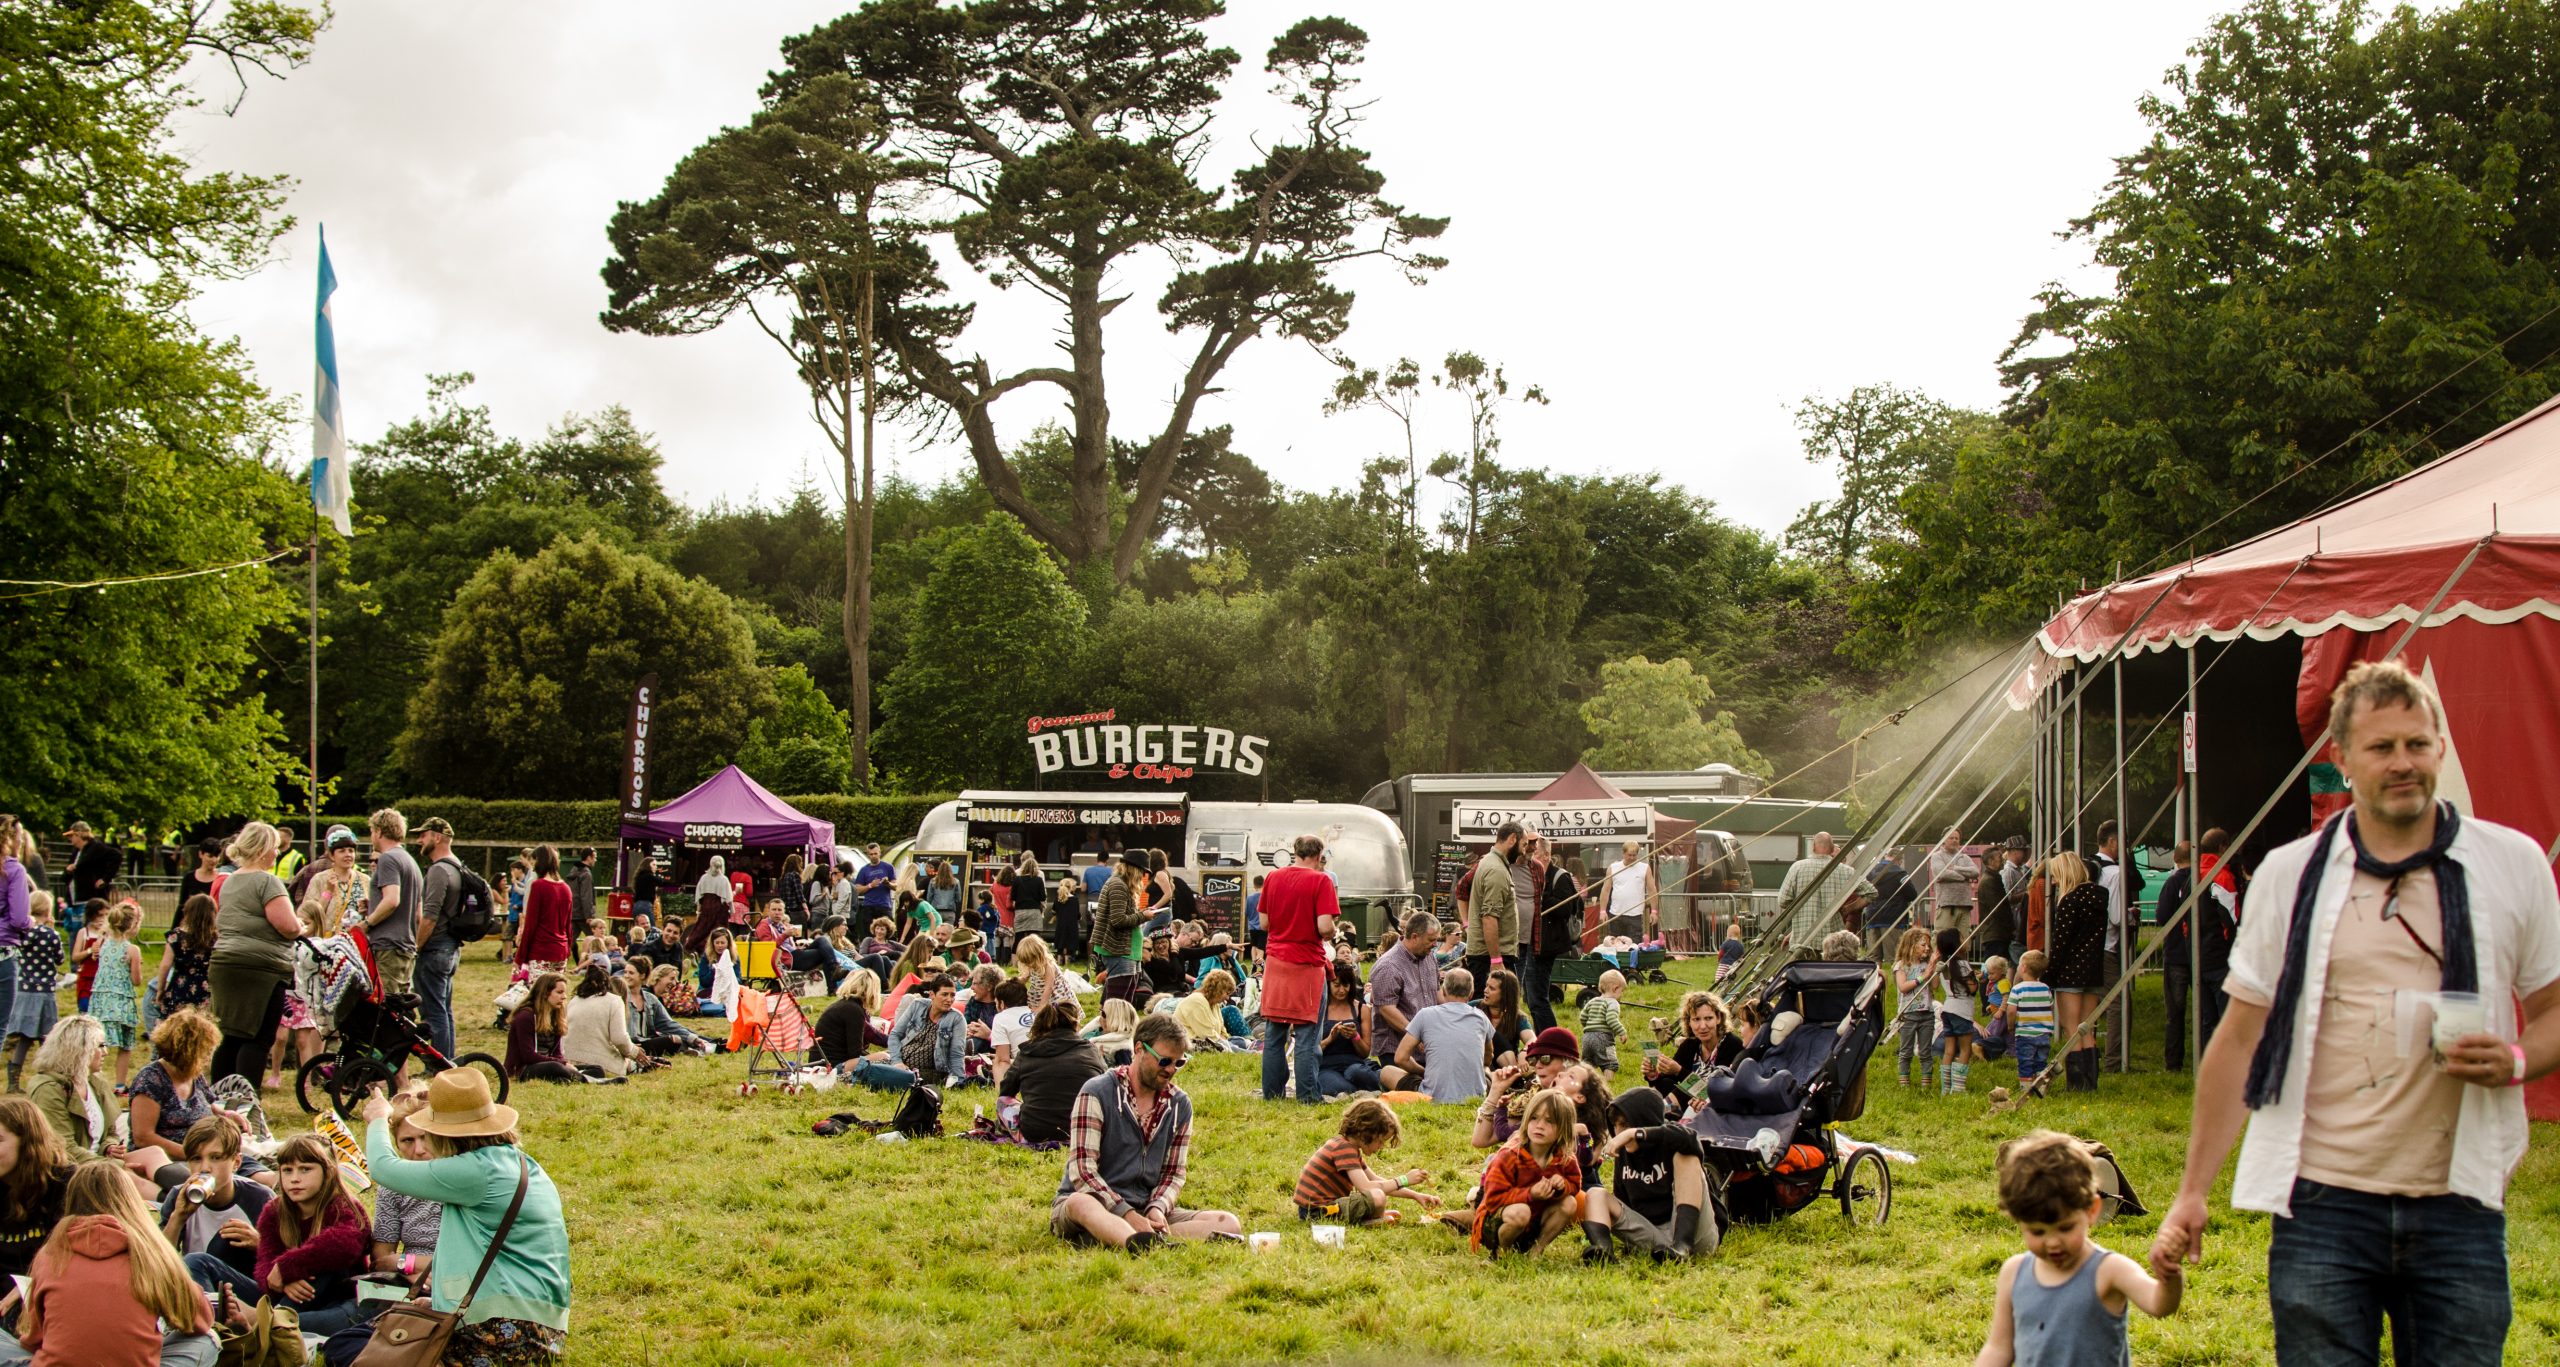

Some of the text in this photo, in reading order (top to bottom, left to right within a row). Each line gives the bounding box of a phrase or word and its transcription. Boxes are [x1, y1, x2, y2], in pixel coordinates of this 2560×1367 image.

[1027, 708, 1116, 734] Gourmet
[631, 686, 650, 809] CHURROS
[1027, 725, 1270, 776] BURGERS
[1109, 763, 1193, 784] & Chips
[1024, 808, 1075, 824] BURGERS
[1080, 809, 1122, 825] CHIPS
[1123, 809, 1135, 825] &
[1135, 809, 1153, 825] Hot
[1156, 810, 1182, 826] Dogs
[1541, 810, 1635, 828] RASCAL
[683, 824, 743, 838] CHURROS
[1553, 828, 1587, 837] STREET
[1589, 827, 1616, 836] FOOD
[1622, 1164, 1654, 1185] Hurley
